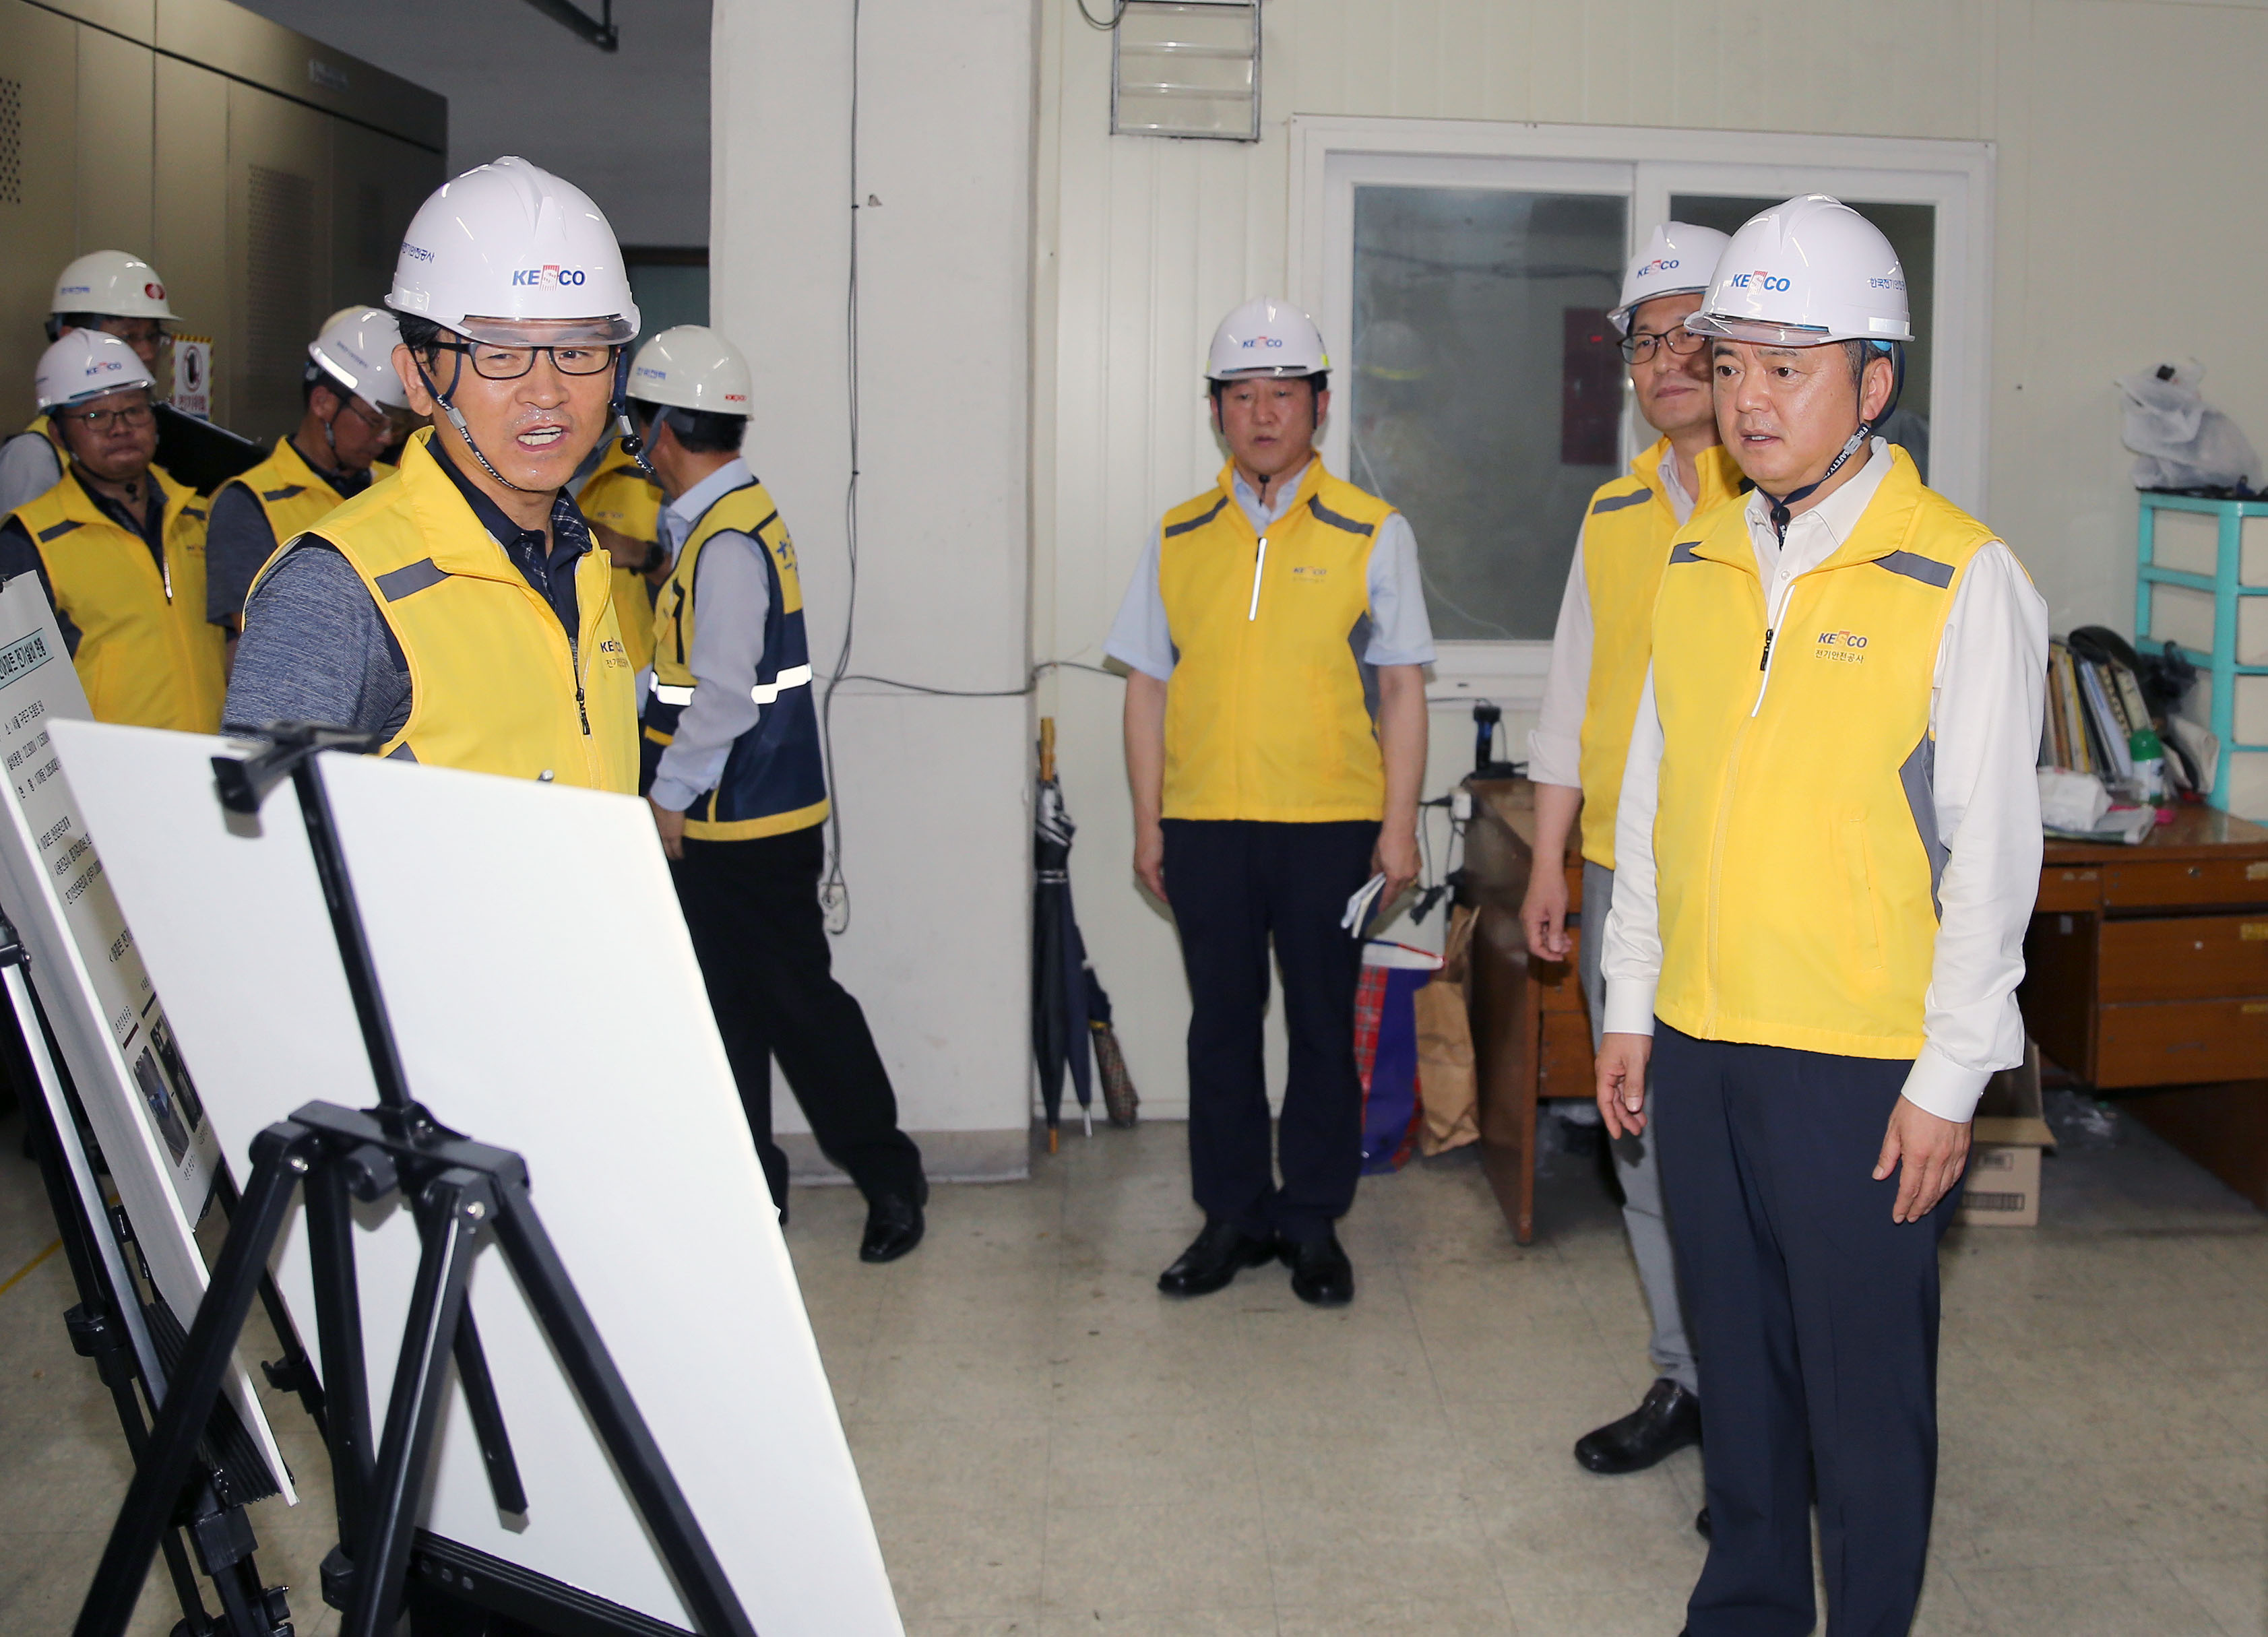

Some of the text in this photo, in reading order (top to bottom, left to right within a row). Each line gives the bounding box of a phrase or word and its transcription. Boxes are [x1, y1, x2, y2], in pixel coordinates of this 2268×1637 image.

[512, 265, 586, 290] KESCO
[1731, 271, 1790, 292] KESCO
[86, 362, 122, 376] KECO
[474, 451, 499, 477] SAFETY
[1830, 450, 1850, 474] SAFETY
[1294, 567, 1326, 575] KECO
[1818, 631, 1867, 648] KESCO
[1816, 649, 1864, 664] 전기안전공사
